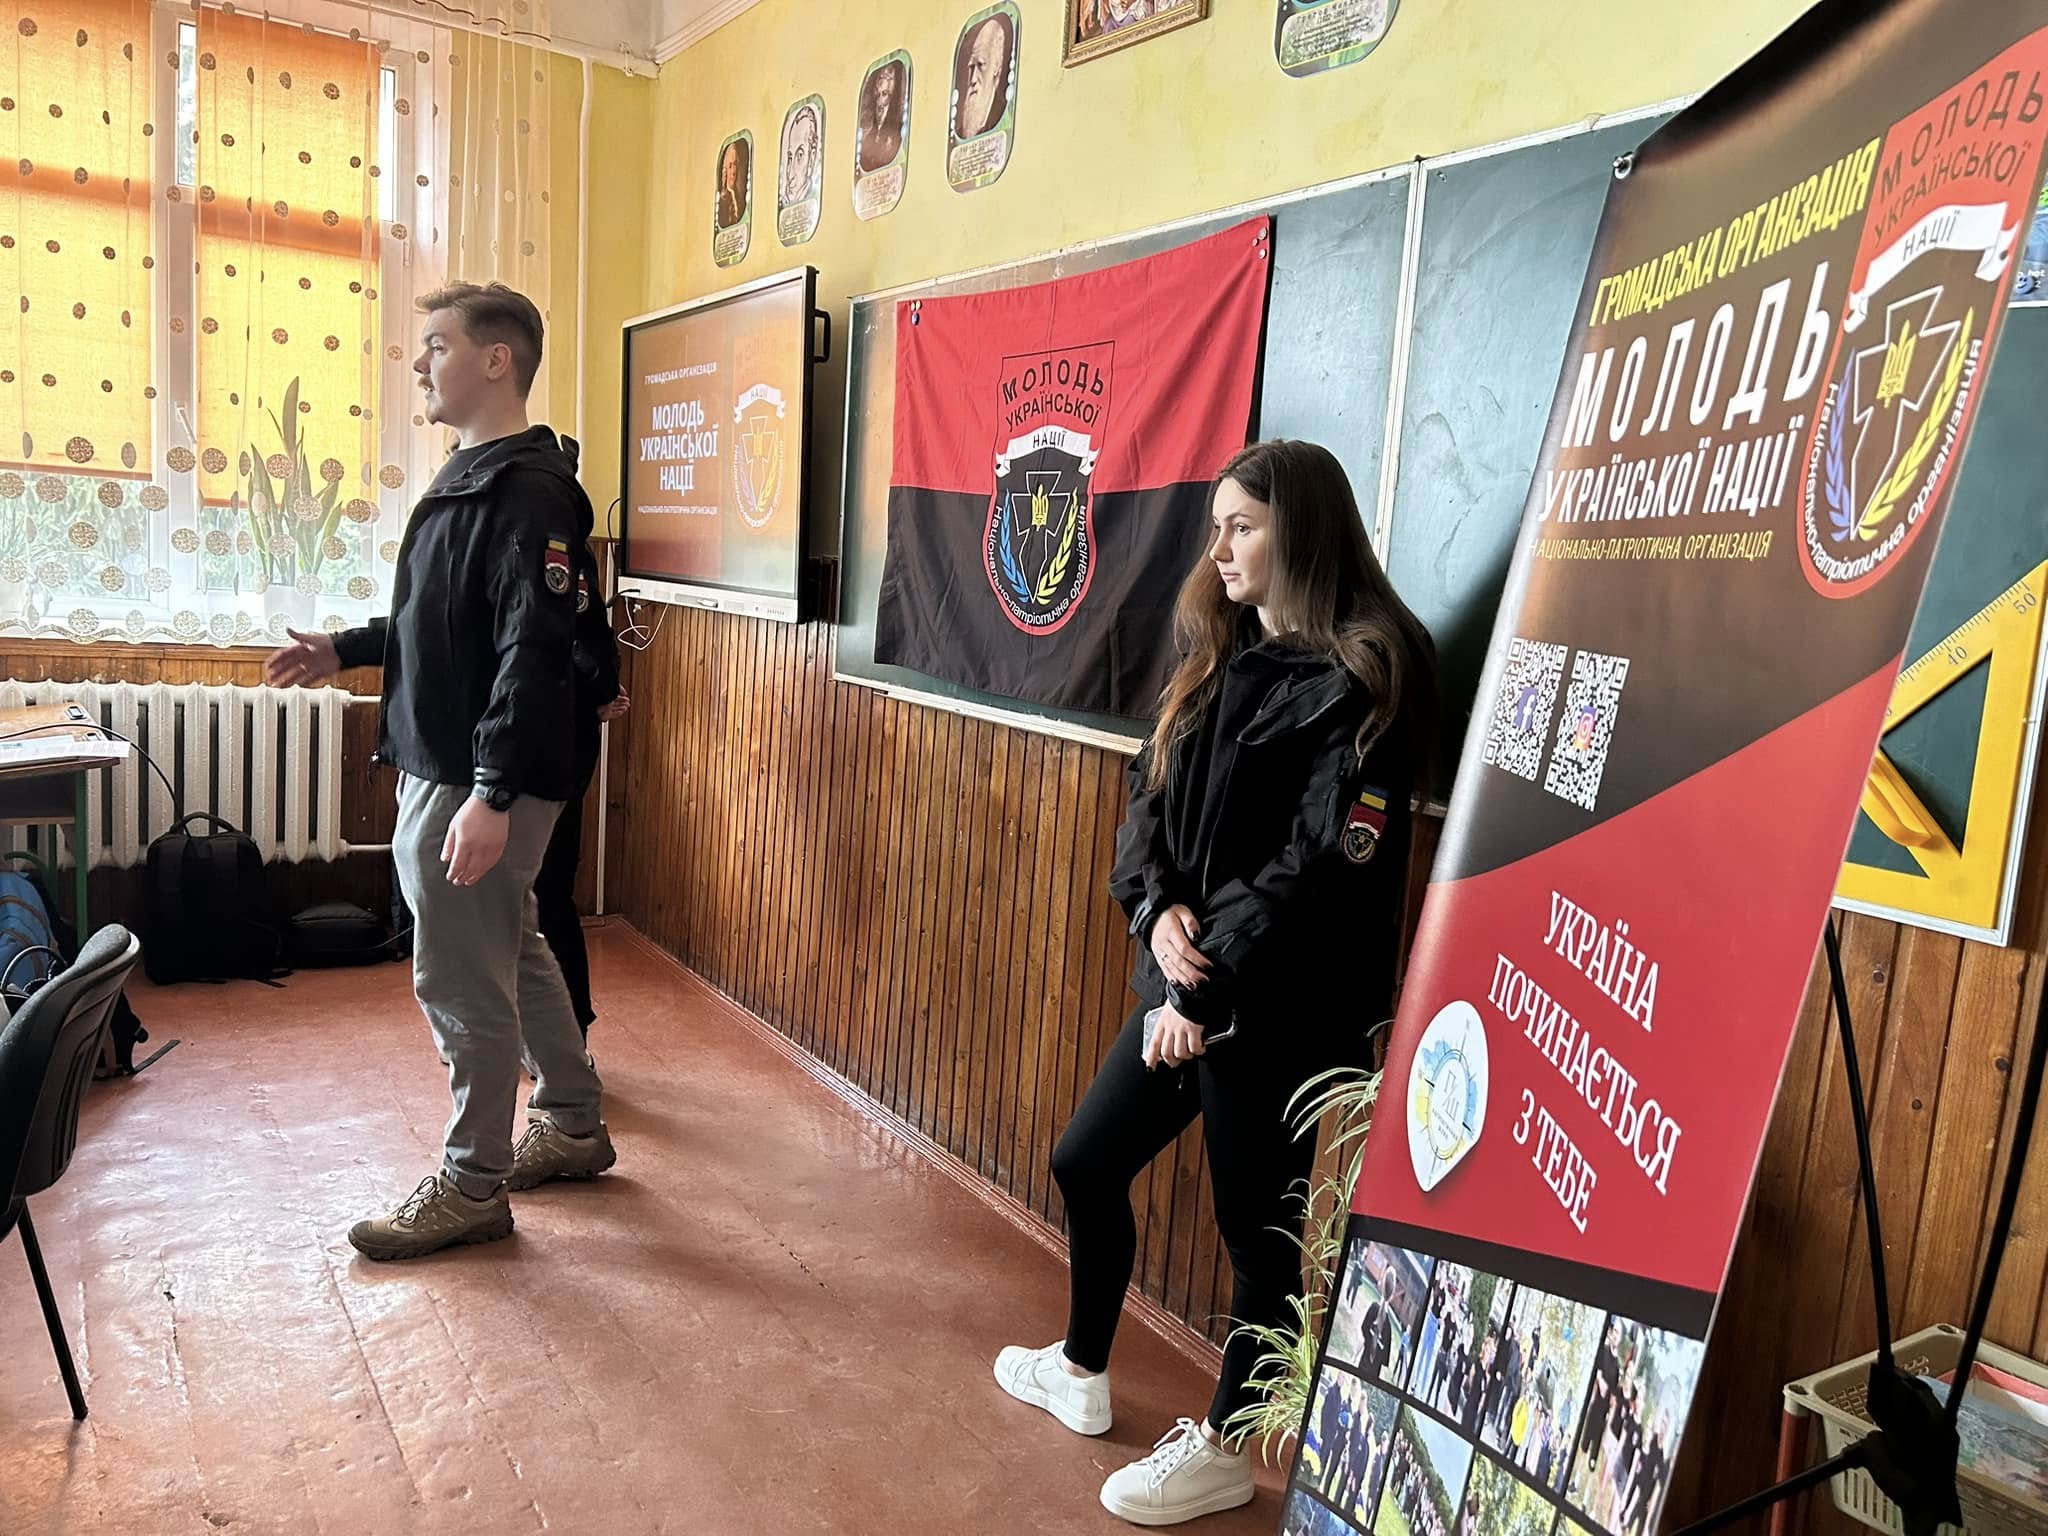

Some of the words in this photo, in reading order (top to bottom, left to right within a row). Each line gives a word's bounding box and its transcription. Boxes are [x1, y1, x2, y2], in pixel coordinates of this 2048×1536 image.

[1880, 70, 2043, 203] МОЛОДЬ
[1874, 140, 2032, 248] УКРАЇНСЬКОЇ
[1589, 225, 1720, 327] ГРОМАДСЬКА
[1717, 136, 1880, 277] ОРГАНІЗАЦІЯ
[1903, 209, 1961, 261] НАЦІЇ
[1561, 261, 1831, 448] МОЛОДЬ
[1002, 359, 1105, 405] МОЛОДЬ
[652, 400, 705, 433] МОЛОДЬ
[1005, 393, 1102, 432] УКРАЇНСЬКОЇ
[640, 424, 719, 462] УКРАЇНСЬКОЇ
[1032, 431, 1067, 450] НАЦІЇ
[659, 459, 695, 497] НАЦІЇ
[1539, 436, 1710, 523] УКРАЇНСЬКОЇ
[1707, 414, 1804, 518] НАЦІЇ
[1683, 529, 1774, 562] ОРГАНІЗАЦІЯ
[2012, 592, 2037, 615] 50
[1947, 646, 1968, 666] 40
[1543, 890, 1660, 1033] УКРАЇНА
[1487, 952, 1682, 1196] ПОЧИНАЄТЬСЯ
[1531, 1105, 1598, 1235] ТЕБЕ
